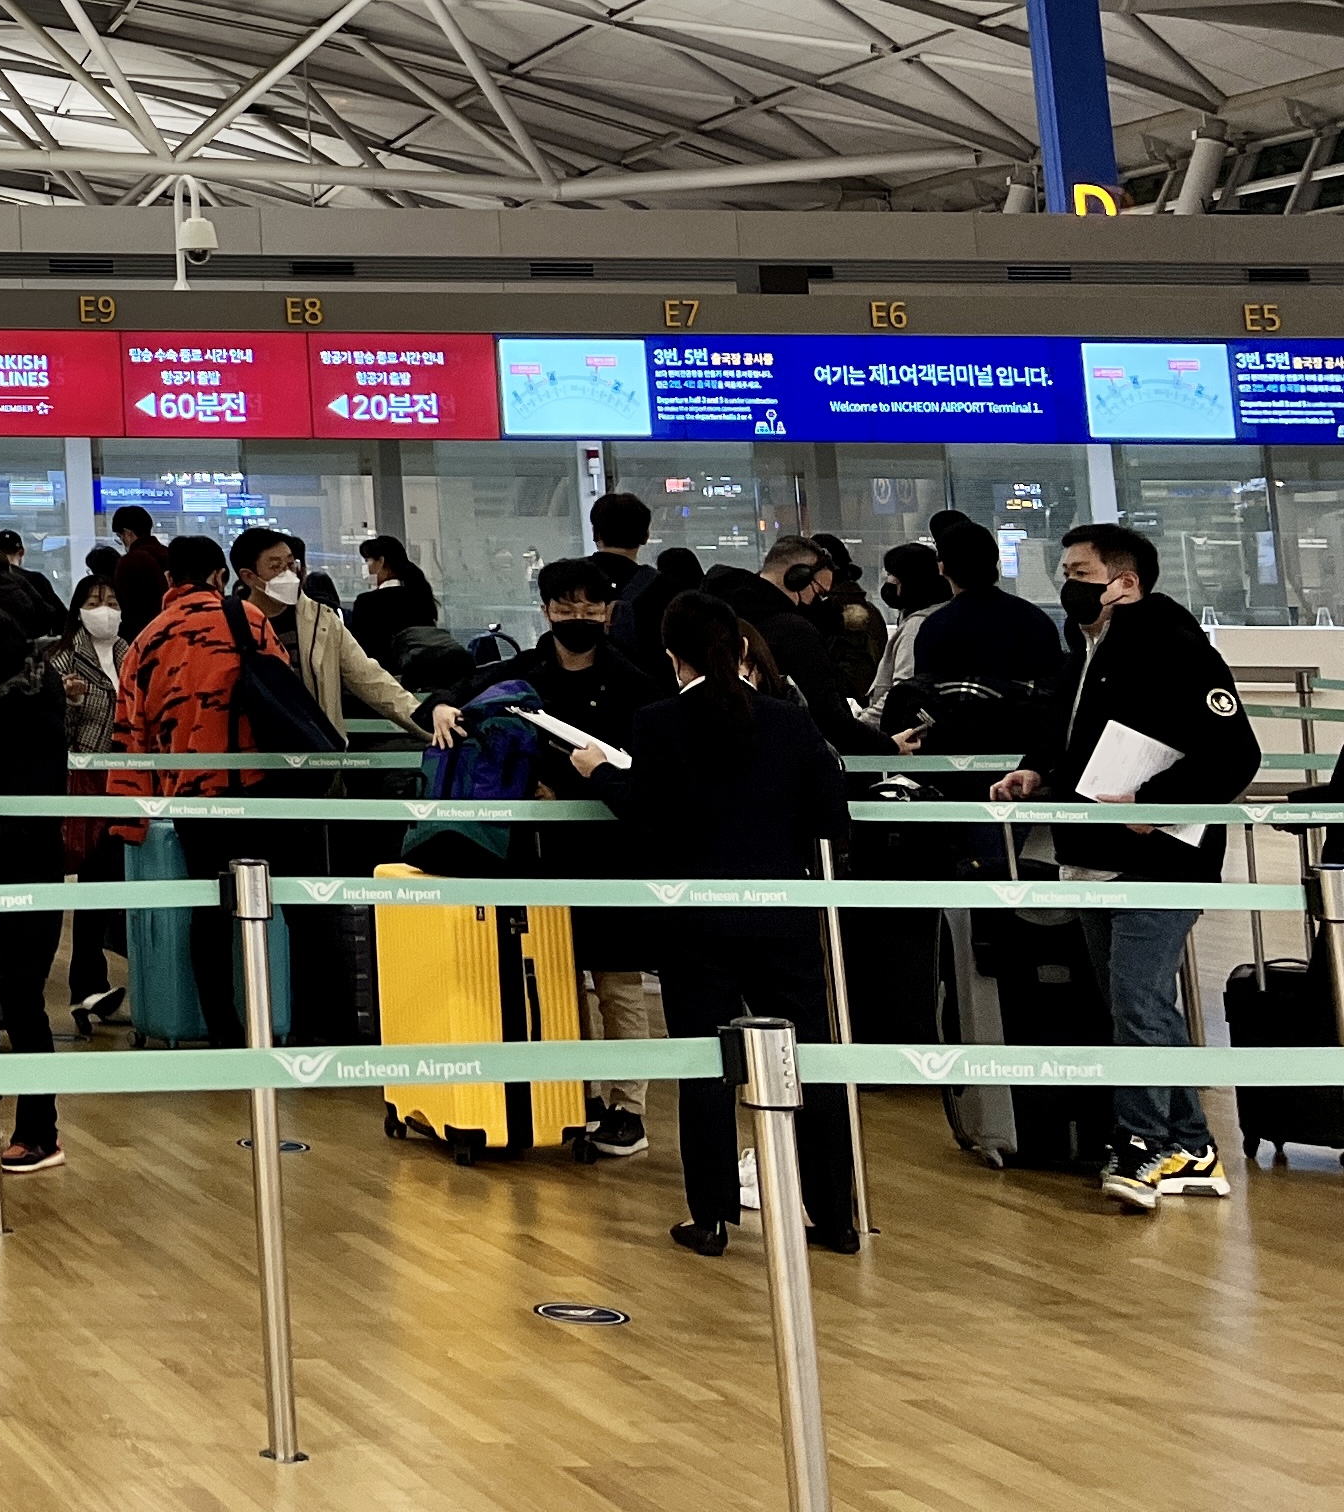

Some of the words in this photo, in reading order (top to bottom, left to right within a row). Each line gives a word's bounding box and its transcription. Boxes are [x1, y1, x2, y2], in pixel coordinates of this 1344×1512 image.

[79, 295, 116, 323] E9
[286, 297, 323, 325] E8
[664, 300, 700, 328] E7
[870, 301, 907, 329] E6
[1243, 303, 1281, 331] E5
[204, 348, 227, 363] 시간
[229, 348, 253, 363] 안내
[320, 351, 352, 365] 항공기
[399, 351, 421, 365] 시간
[422, 351, 444, 366] 안내
[684, 348, 708, 366] 5번
[1266, 352, 1290, 369] 5번
[161, 370, 195, 386] 항공기
[355, 371, 388, 386] 항공기
[814, 365, 866, 385] 여기는
[868, 363, 993, 387] 제1여객터미널
[996, 366, 1053, 387] 입니다.
[160, 391, 247, 422] 60분전
[352, 392, 439, 423] 20분전
[829, 400, 878, 413] Welcome
[879, 401, 890, 412] to
[891, 401, 939, 413] INCHEON
[940, 401, 986, 413] AIRPORT
[987, 401, 1032, 414] Terminal
[169, 805, 208, 816] Incheon
[211, 805, 245, 816] Airport
[436, 807, 475, 817] Incheon
[477, 807, 512, 818] Airport
[1015, 810, 1052, 819] Incheon
[1055, 810, 1088, 821] Airport
[342, 886, 392, 900] Incheon
[396, 886, 442, 903] Airport
[690, 889, 739, 903] Incheon
[743, 889, 787, 904] Airport
[1032, 890, 1082, 904] Incheon
[1085, 890, 1127, 905] Airport
[337, 1060, 410, 1079] Incheon
[415, 1058, 482, 1080] Airport
[964, 1059, 1035, 1079] Incheon
[1040, 1060, 1104, 1080] Airport
